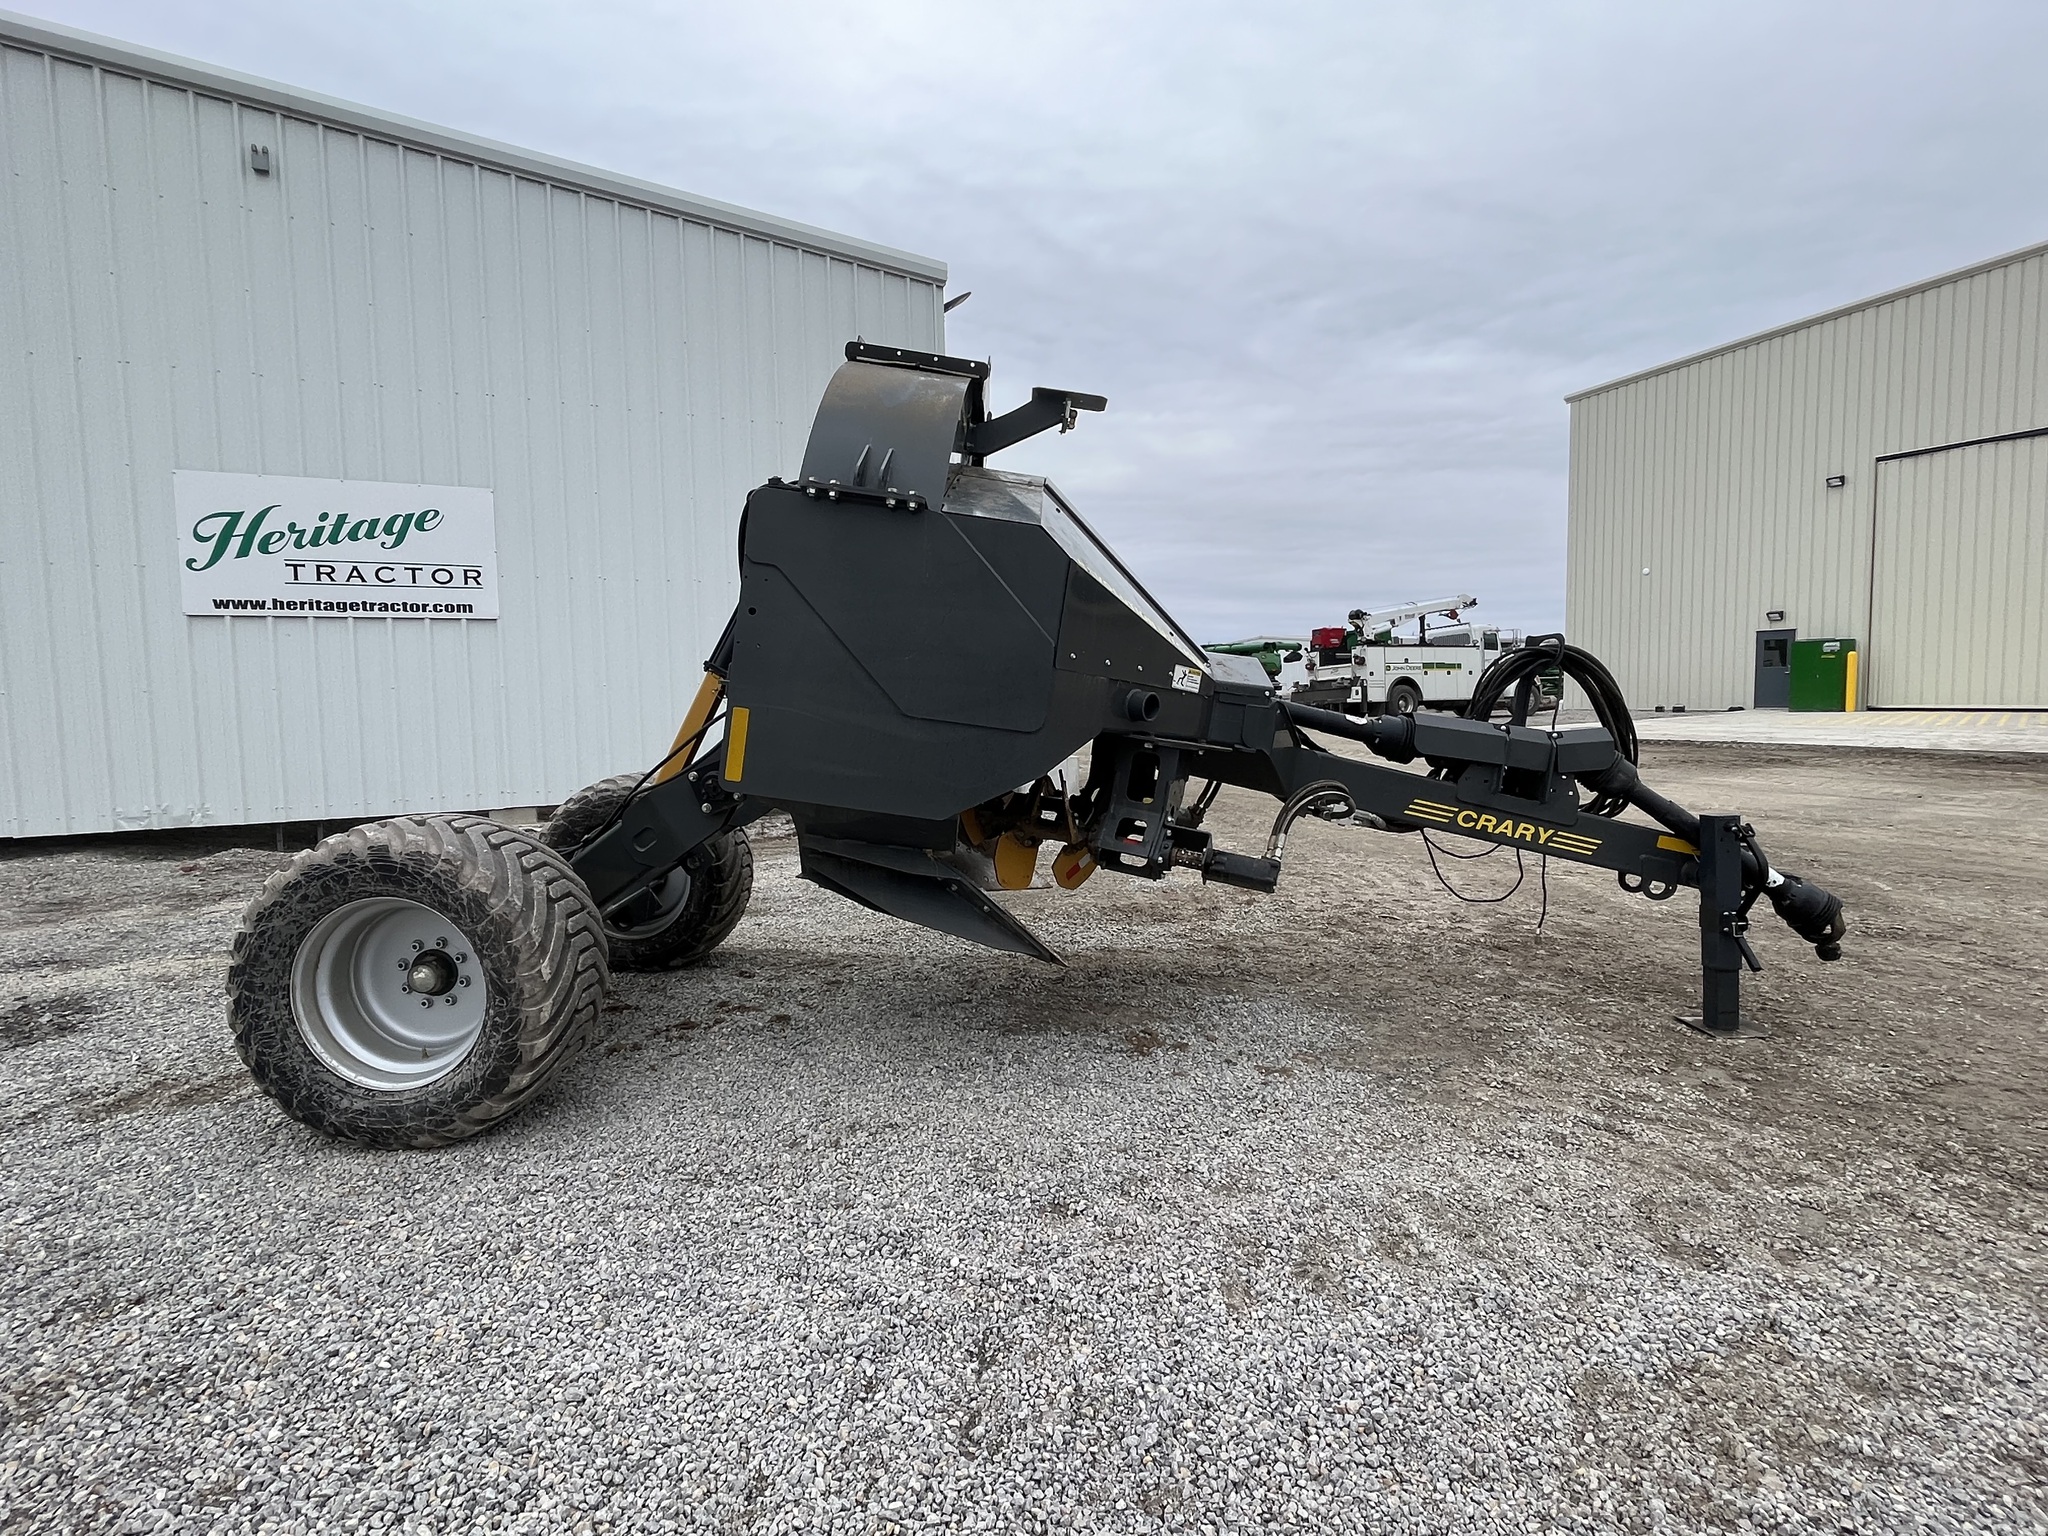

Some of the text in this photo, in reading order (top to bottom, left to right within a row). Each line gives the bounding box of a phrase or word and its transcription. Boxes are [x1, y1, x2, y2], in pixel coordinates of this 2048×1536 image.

[185, 504, 444, 572] Heritage
[284, 563, 483, 586] TRACTOR
[212, 597, 473, 614] www.heritagetractor.com
[1456, 810, 1556, 845] CRARY
